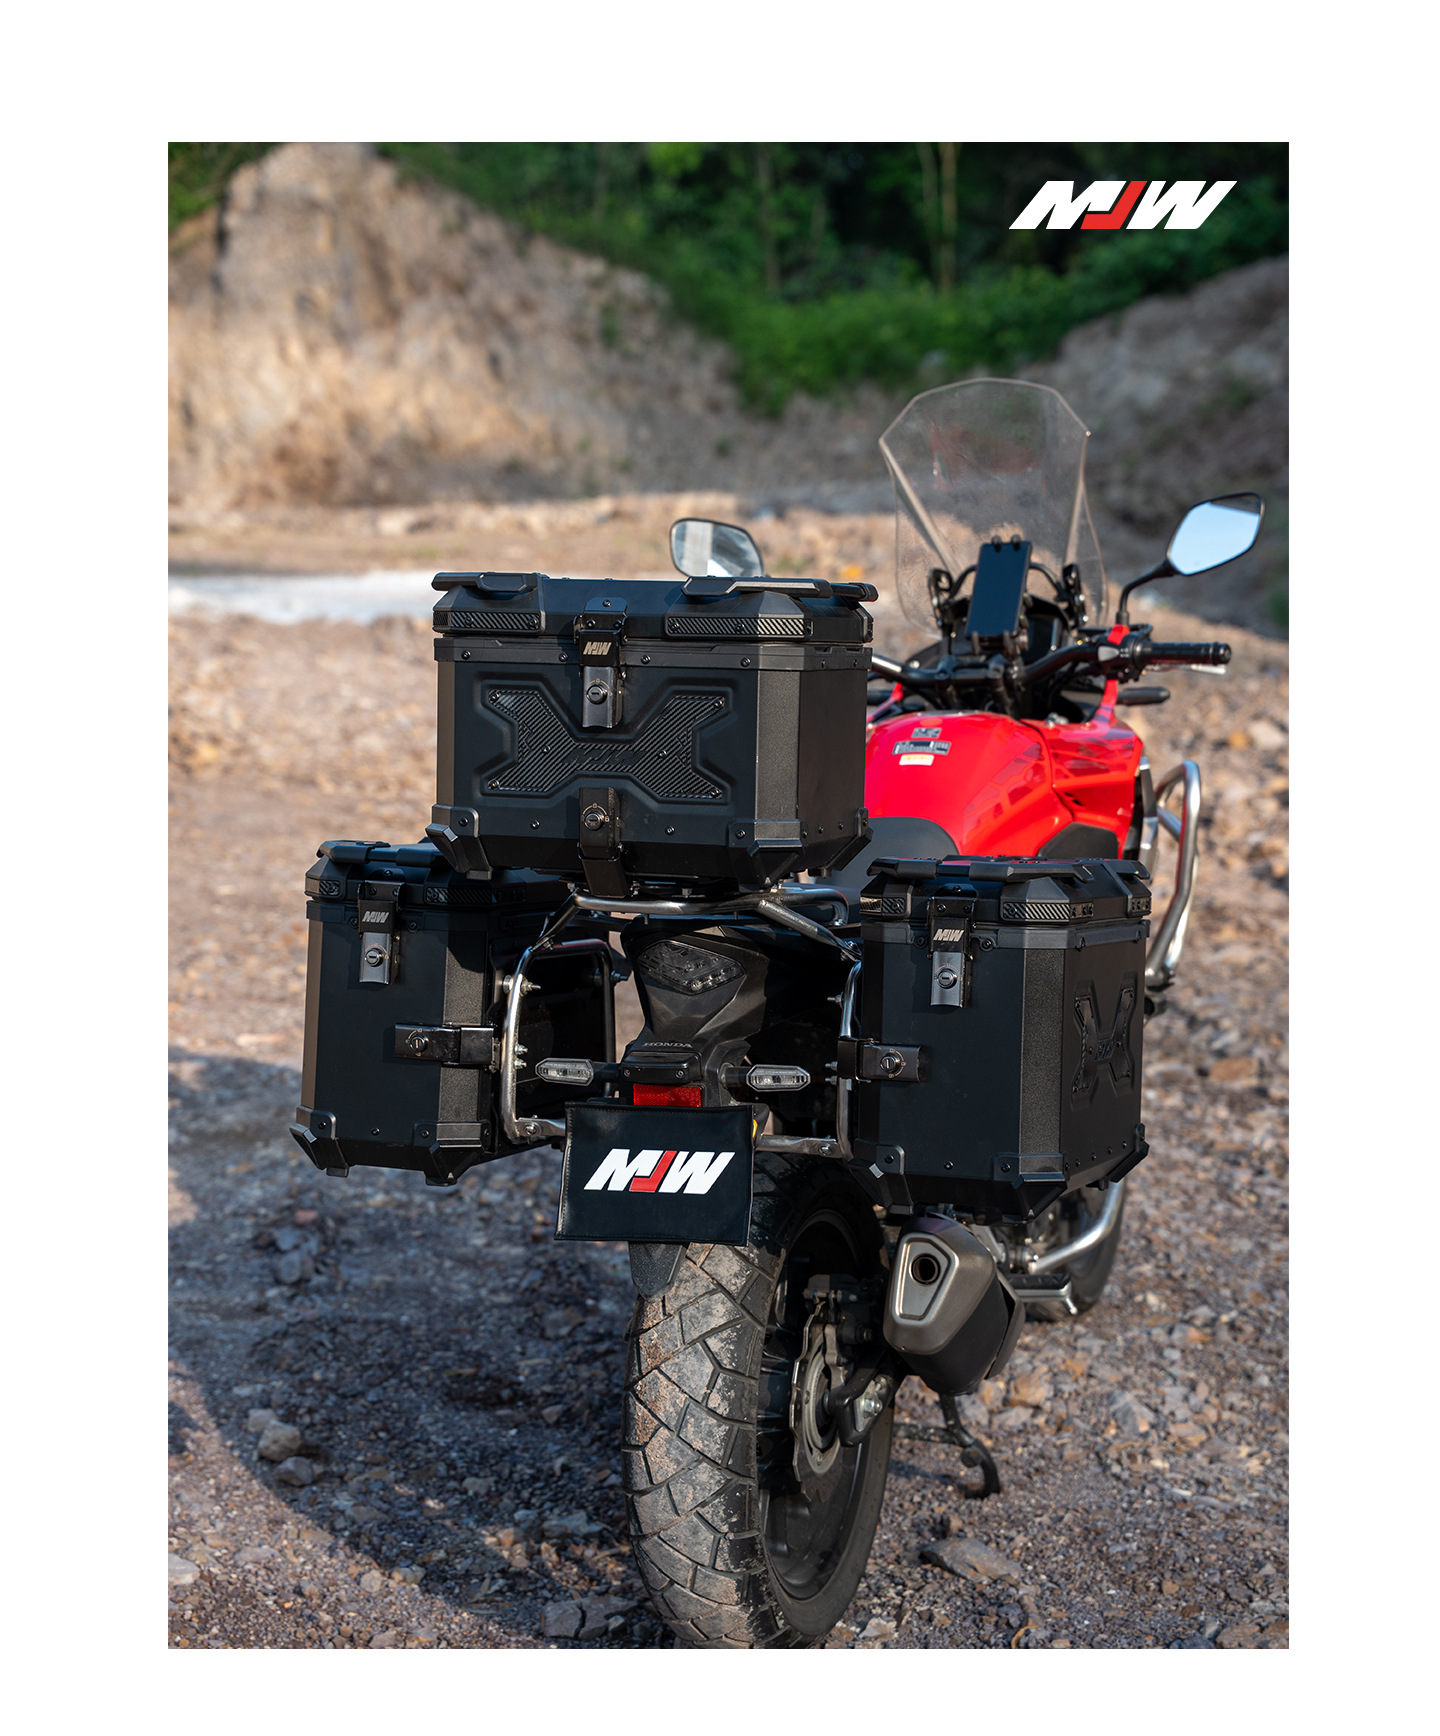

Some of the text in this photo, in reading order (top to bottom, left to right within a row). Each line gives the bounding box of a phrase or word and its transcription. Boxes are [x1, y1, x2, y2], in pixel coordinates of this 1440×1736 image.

[583, 641, 612, 655] MJW
[362, 911, 390, 923] MJW
[933, 929, 965, 942] MJW
[643, 1041, 693, 1049] HONDA
[583, 1148, 736, 1195] MJW
